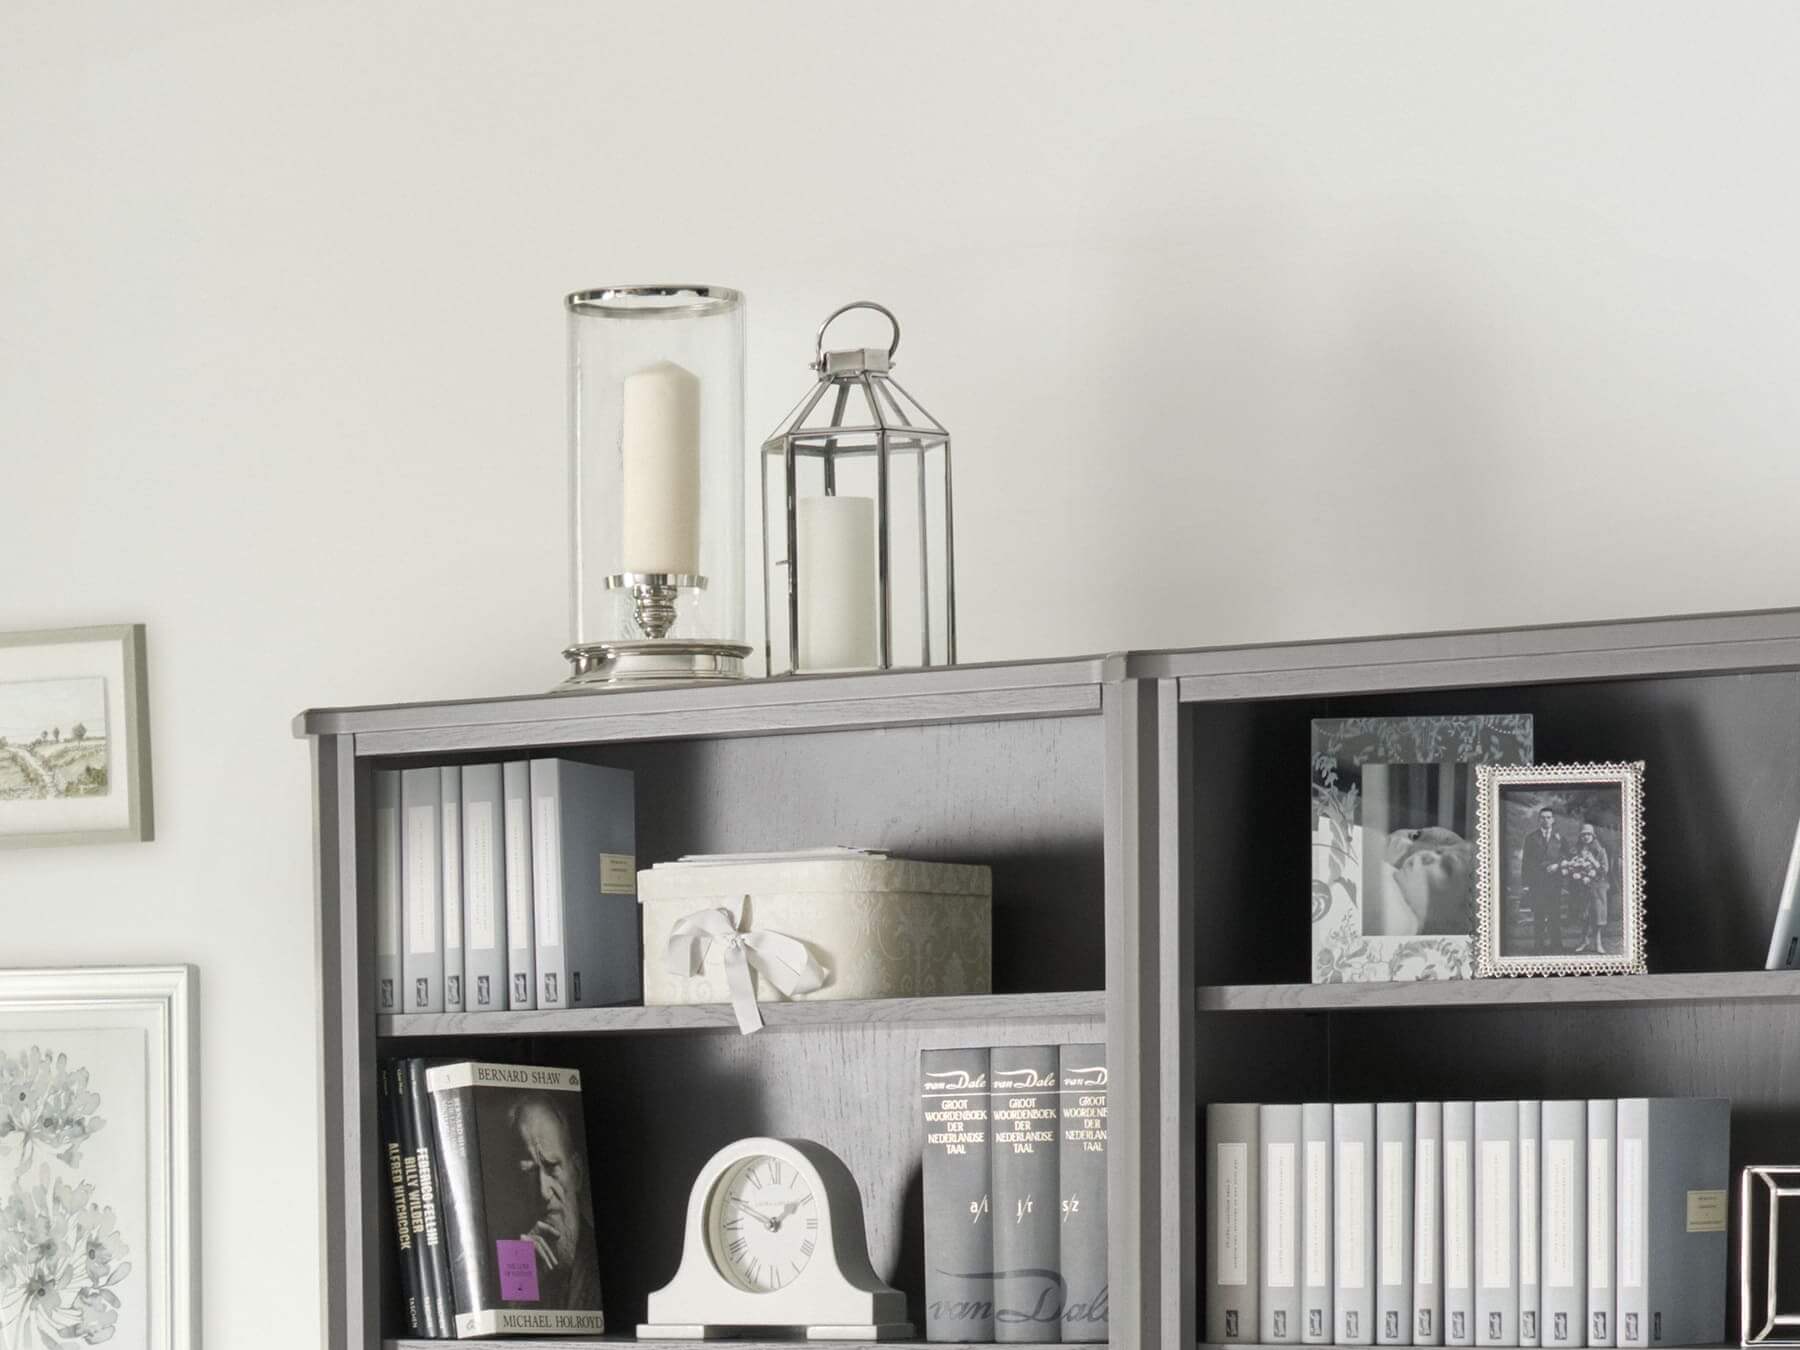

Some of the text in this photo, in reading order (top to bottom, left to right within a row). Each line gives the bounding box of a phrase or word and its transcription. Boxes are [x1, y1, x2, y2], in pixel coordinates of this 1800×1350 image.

[478, 1068, 561, 1084] BERNARD SHAW
[924, 1071, 986, 1090] van Dale
[994, 1069, 1055, 1088] Dale
[1063, 1078, 1084, 1087] van
[942, 1099, 968, 1110] GROOT
[1009, 1098, 1036, 1109] GROOT
[1079, 1095, 1106, 1106] GROOT
[925, 1110, 987, 1121] WOORDENBOEK
[994, 1108, 1056, 1120] WOORDENBOEK
[947, 1122, 963, 1132] DER
[1014, 1121, 1031, 1131] DER
[1084, 1119, 1101, 1129] DER
[928, 1132, 984, 1144] NEDERLANDSE
[996, 1131, 1055, 1142] NEDERLANDSE
[1065, 1130, 1107, 1140] NEDERLAN
[946, 1144, 966, 1154] TAAL
[1013, 1143, 1034, 1153] TAAL
[1083, 1142, 1104, 1152] TAAL
[388, 1142, 411, 1250] ALFRED HITCHCOCK
[404, 1156, 424, 1233] BILLY WILDER
[416, 1148, 438, 1246] FEDERICO FELLINI
[1062, 1193, 1080, 1223] s/z
[928, 1300, 993, 1320] van
[503, 1314, 604, 1329] MICHAEL HOLROYD
